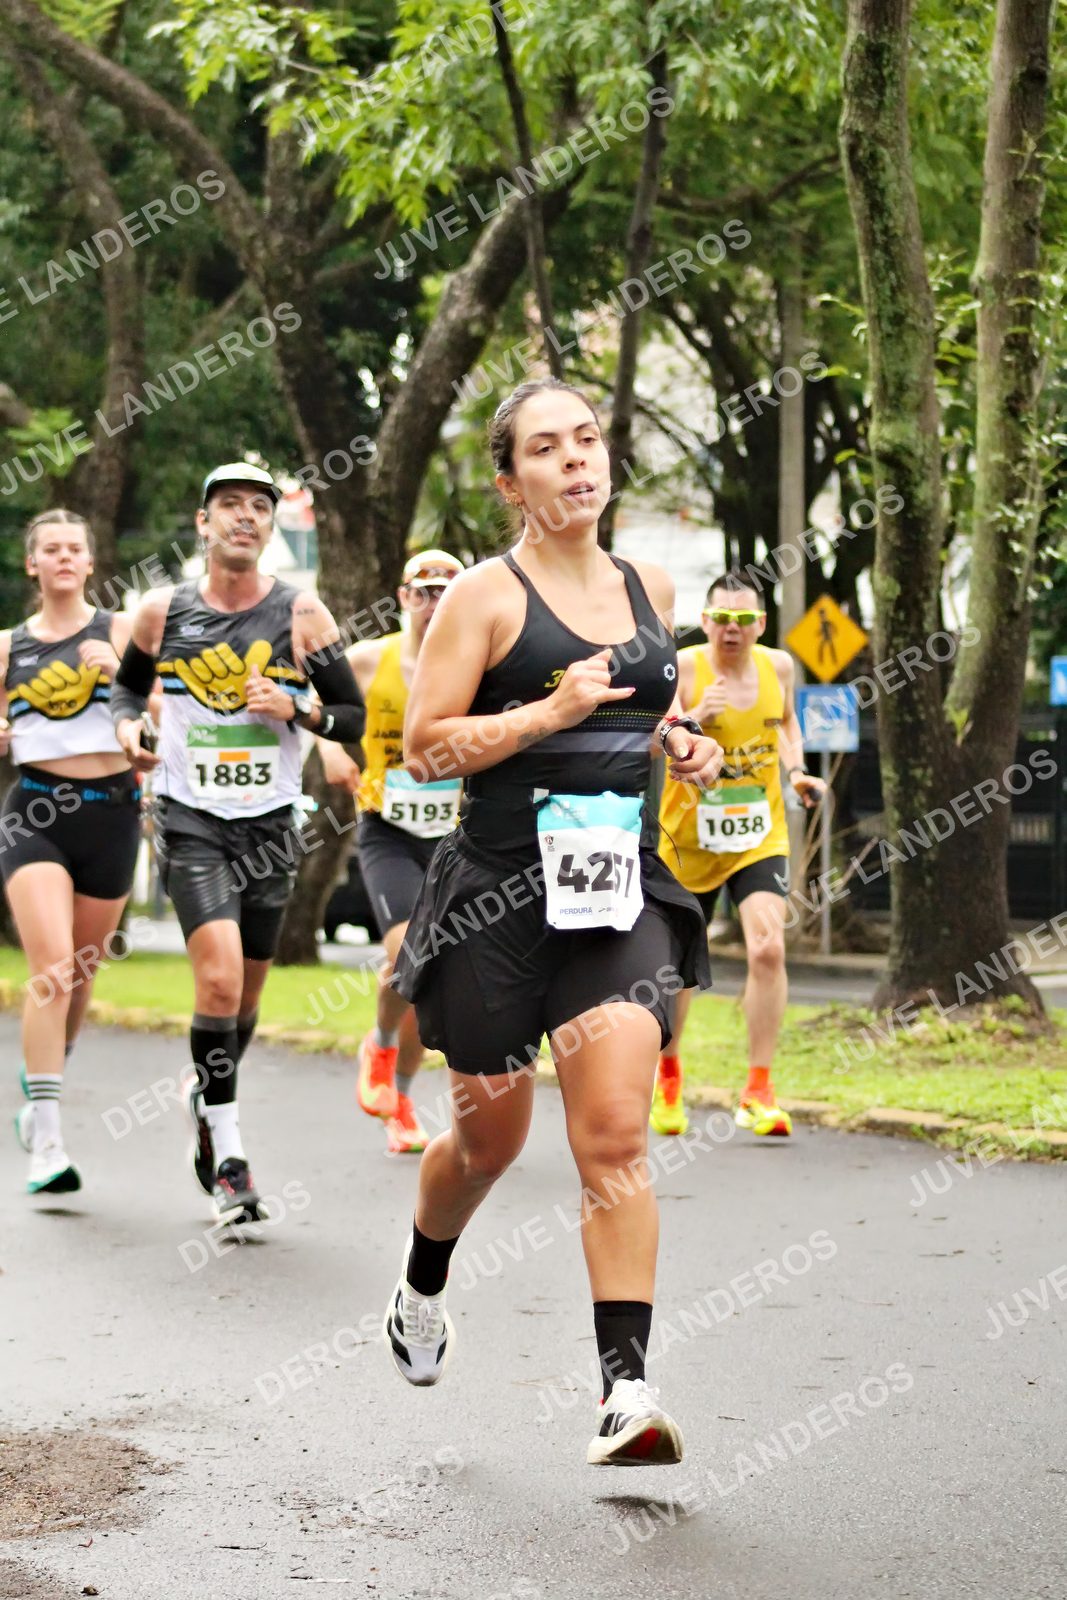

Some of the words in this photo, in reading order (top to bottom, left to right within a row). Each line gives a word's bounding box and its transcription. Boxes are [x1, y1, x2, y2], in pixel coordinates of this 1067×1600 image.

[195, 762, 273, 787] 1883
[389, 802, 454, 822] 5193
[705, 815, 765, 836] 1038
[559, 906, 593, 915] PERDURA
